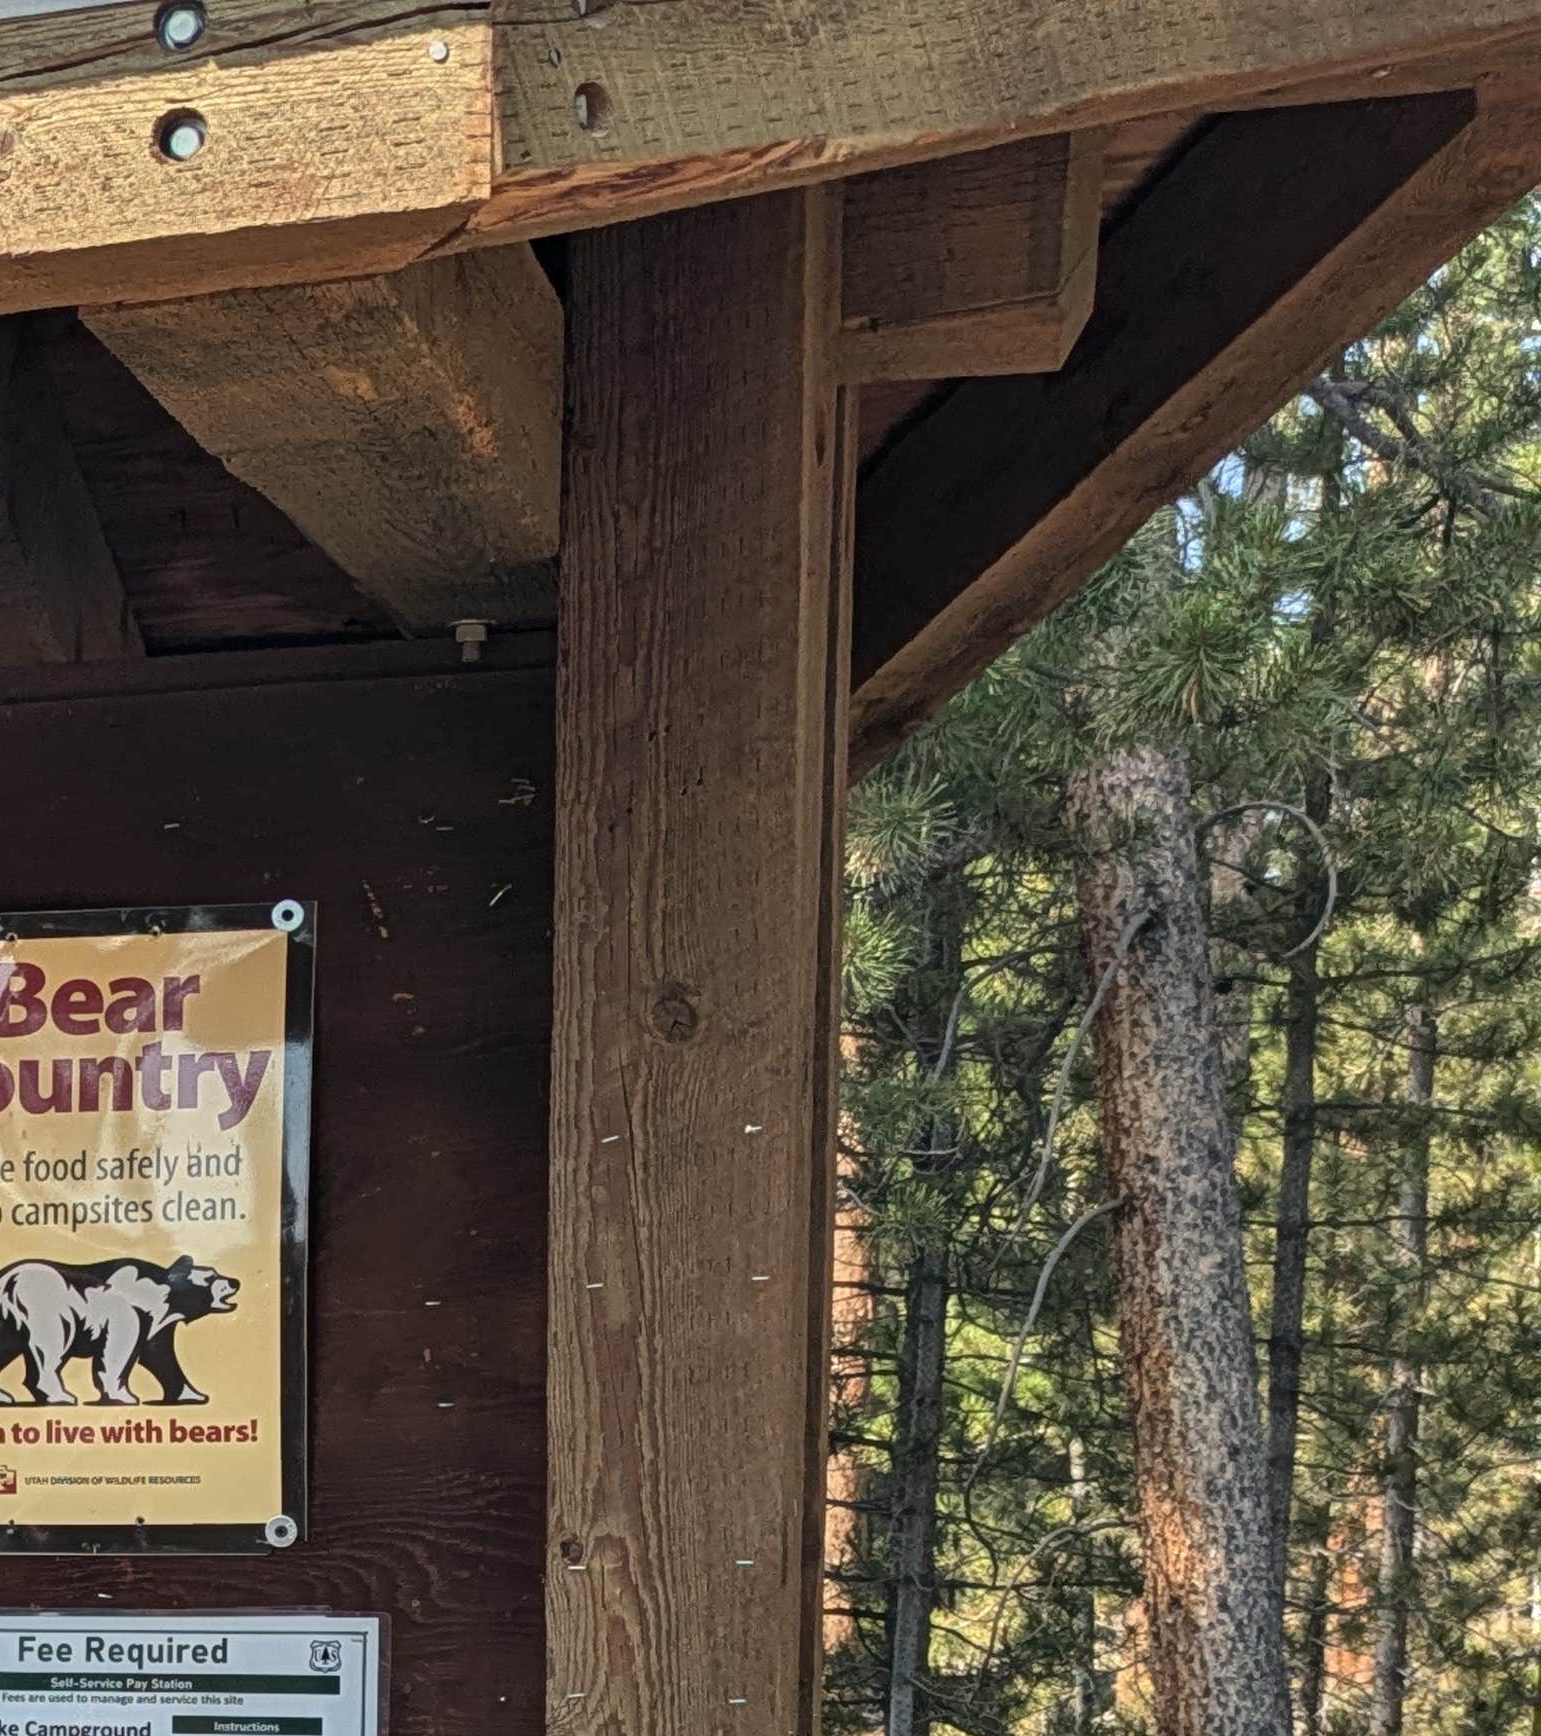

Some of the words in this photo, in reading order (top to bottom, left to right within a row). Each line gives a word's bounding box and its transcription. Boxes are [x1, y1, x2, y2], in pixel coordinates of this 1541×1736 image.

[24, 1150, 87, 1182] food
[96, 1147, 179, 1186] safely
[187, 1145, 242, 1177] and
[11, 1196, 153, 1234] campsites
[163, 1192, 247, 1223] clean.
[11, 1423, 40, 1444] to
[46, 1420, 95, 1444] live
[101, 1419, 163, 1443] with
[170, 1419, 259, 1443] bears!
[25, 1476, 49, 1486] UTAH
[50, 1476, 90, 1486] DIVISION
[91, 1476, 103, 1485] OF
[105, 1476, 146, 1485] WILDLIFE
[148, 1475, 201, 1485] RESOURCES
[18, 1636, 73, 1663] Fee
[85, 1636, 228, 1670] Required
[50, 1677, 122, 1690] Self-Service
[126, 1678, 148, 1691] Pay
[151, 1678, 193, 1690] Station
[2, 1692, 25, 1703] Fees
[28, 1694, 45, 1703] are
[48, 1692, 74, 1703] used
[76, 1694, 88, 1704] to
[91, 1695, 133, 1706] manage
[136, 1693, 157, 1704] and
[160, 1694, 198, 1705] service
[201, 1694, 221, 1705] this
[224, 1695, 244, 1706] site
[214, 1721, 279, 1733] Instructions
